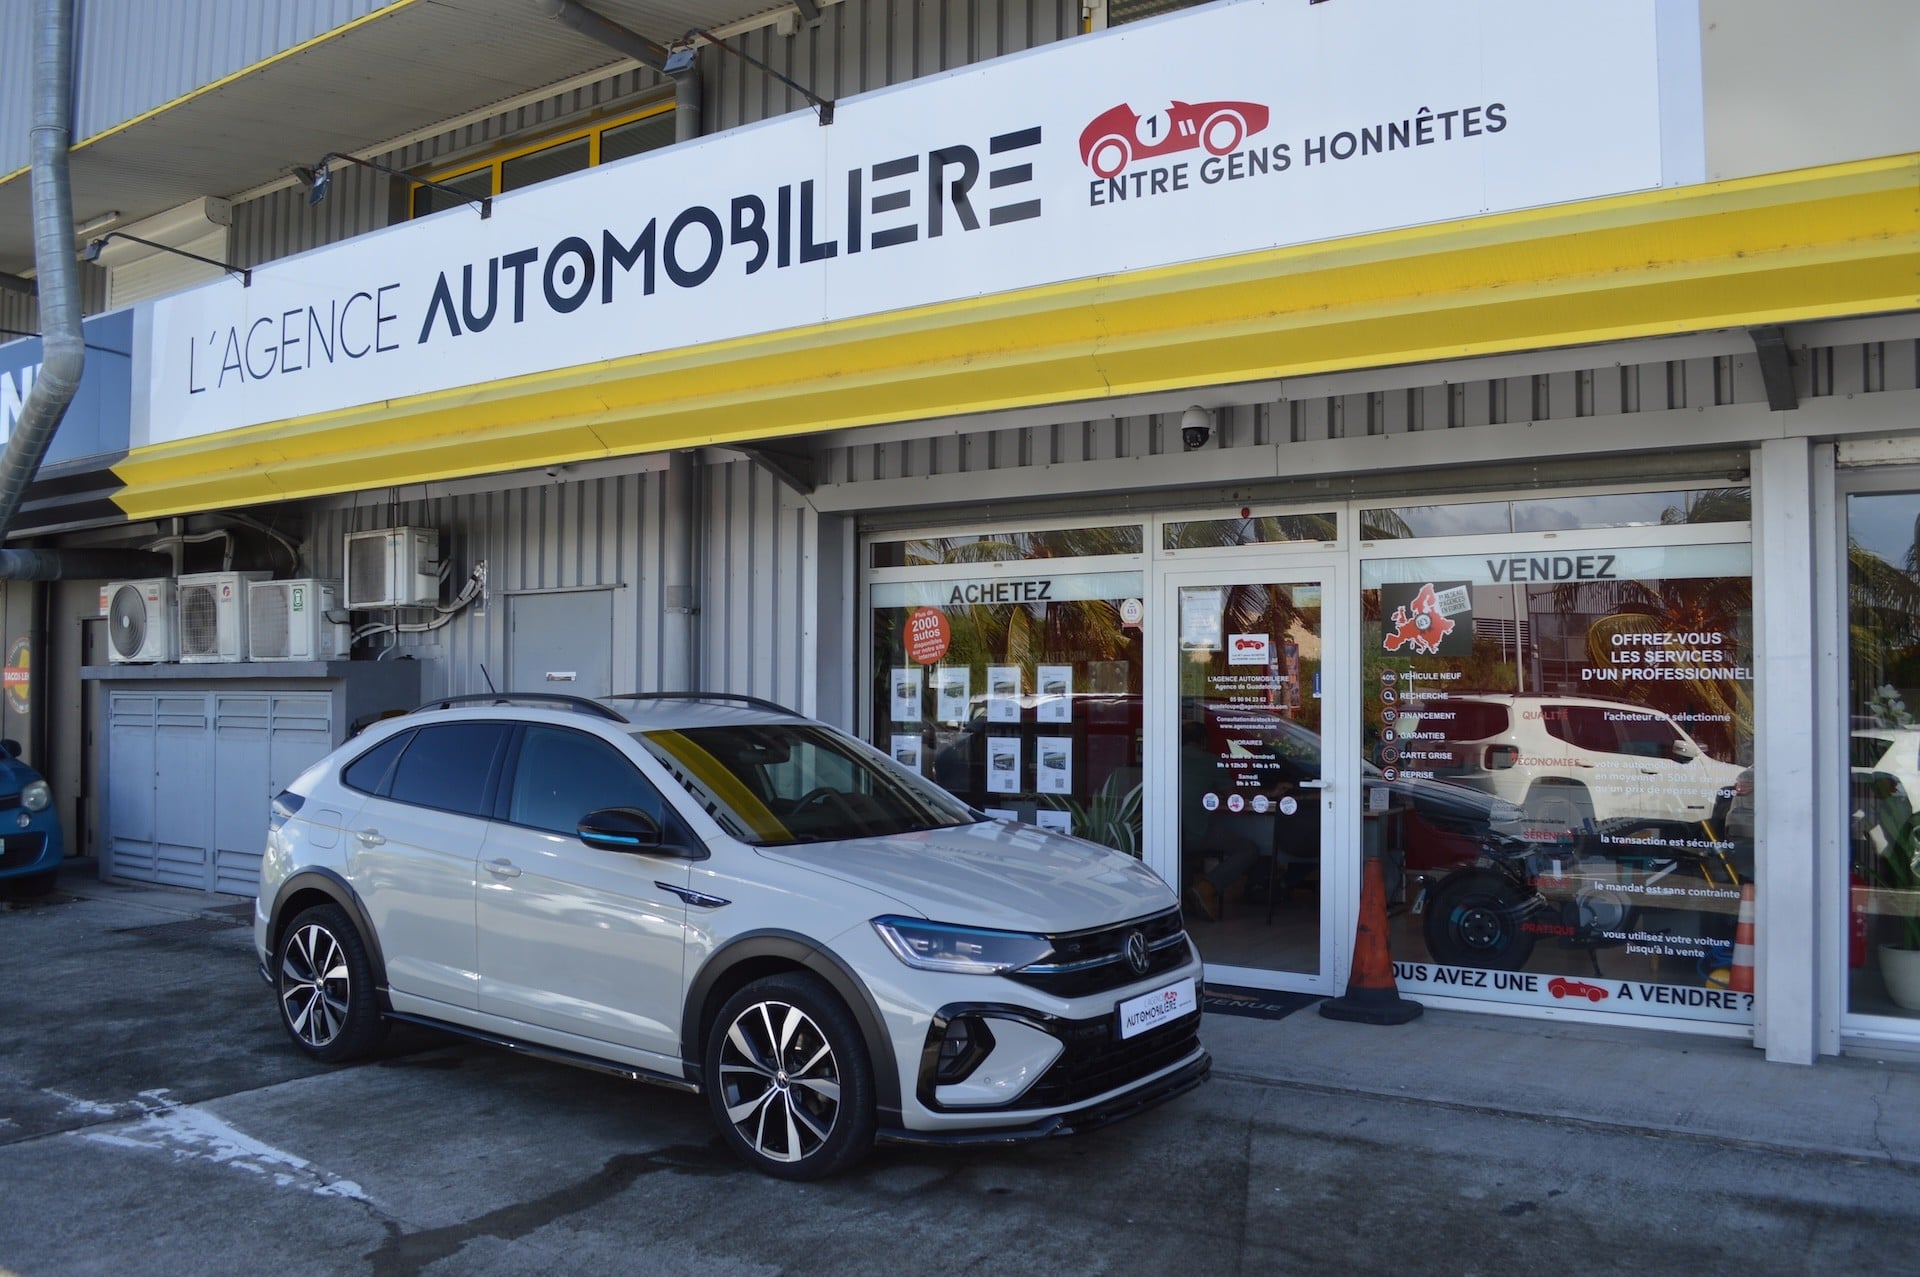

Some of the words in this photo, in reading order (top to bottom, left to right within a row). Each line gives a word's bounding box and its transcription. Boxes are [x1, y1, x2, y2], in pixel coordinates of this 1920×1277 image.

[1146, 115, 1157, 138] 1
[1090, 162, 1190, 207] ENTRE
[1200, 143, 1291, 185] GENS
[1304, 102, 1508, 167] HONNÊTES
[189, 283, 401, 395] L'AGENCE
[418, 125, 1042, 345] AUTOMOBILIERE
[1486, 554, 1617, 583] VENDEZ
[950, 580, 1052, 604] ACHETEZ
[912, 615, 939, 633] 2000
[913, 628, 940, 642] autos
[1611, 632, 1722, 646] OFFREZ-VOUS
[1610, 651, 1641, 663] LES
[1644, 649, 1723, 663] SERVICES
[1440, 671, 1462, 680] NEUF
[1581, 669, 1618, 681] D'UN
[1622, 667, 1755, 681] PROFESSIONNEL
[1215, 683, 1237, 691] Agence
[1246, 683, 1282, 691] Guadeloupe
[1400, 692, 1449, 700] RECHERCHE
[1400, 712, 1456, 720] FINANCEMENT
[1604, 711, 1653, 721] l'acheteur
[1654, 711, 1671, 722] est
[1672, 710, 1731, 722] sélectionné
[1400, 731, 1446, 740] GARANTIES
[1400, 751, 1427, 759] CARTE
[1428, 752, 1453, 760] GRISE
[1594, 760, 1620, 769] votre
[1622, 759, 1680, 770] automobile
[1400, 769, 1434, 779] REPRISE
[1594, 773, 1607, 781] en
[1609, 774, 1656, 784] moyenne
[1668, 773, 1688, 783] 500
[1594, 786, 1623, 795] qu'un
[1625, 785, 1644, 796] prix
[1647, 785, 1660, 795] de
[1662, 786, 1698, 797] reprise
[1701, 788, 1737, 799] garage
[1600, 834, 1610, 843] la
[1611, 835, 1667, 847] transaction
[1668, 838, 1685, 847] est
[1686, 837, 1735, 850] sécurisée
[1594, 881, 1604, 890] le
[1606, 881, 1643, 893] mandat
[1645, 885, 1663, 894] est
[1663, 885, 1686, 896] sans
[1687, 886, 1741, 899] contrainte
[1602, 930, 1626, 940] vous
[1627, 931, 1663, 942] utilisez
[1665, 933, 1692, 945] votre
[1693, 934, 1731, 948] voiture
[1626, 942, 1663, 955] jusqu'à
[1664, 944, 1674, 956] la
[1675, 946, 1706, 958] vente
[1432, 967, 1488, 986] AVEZ
[1494, 973, 1538, 993] UNE
[1616, 982, 1633, 1000] A
[1642, 984, 1737, 1010] VENDRE
